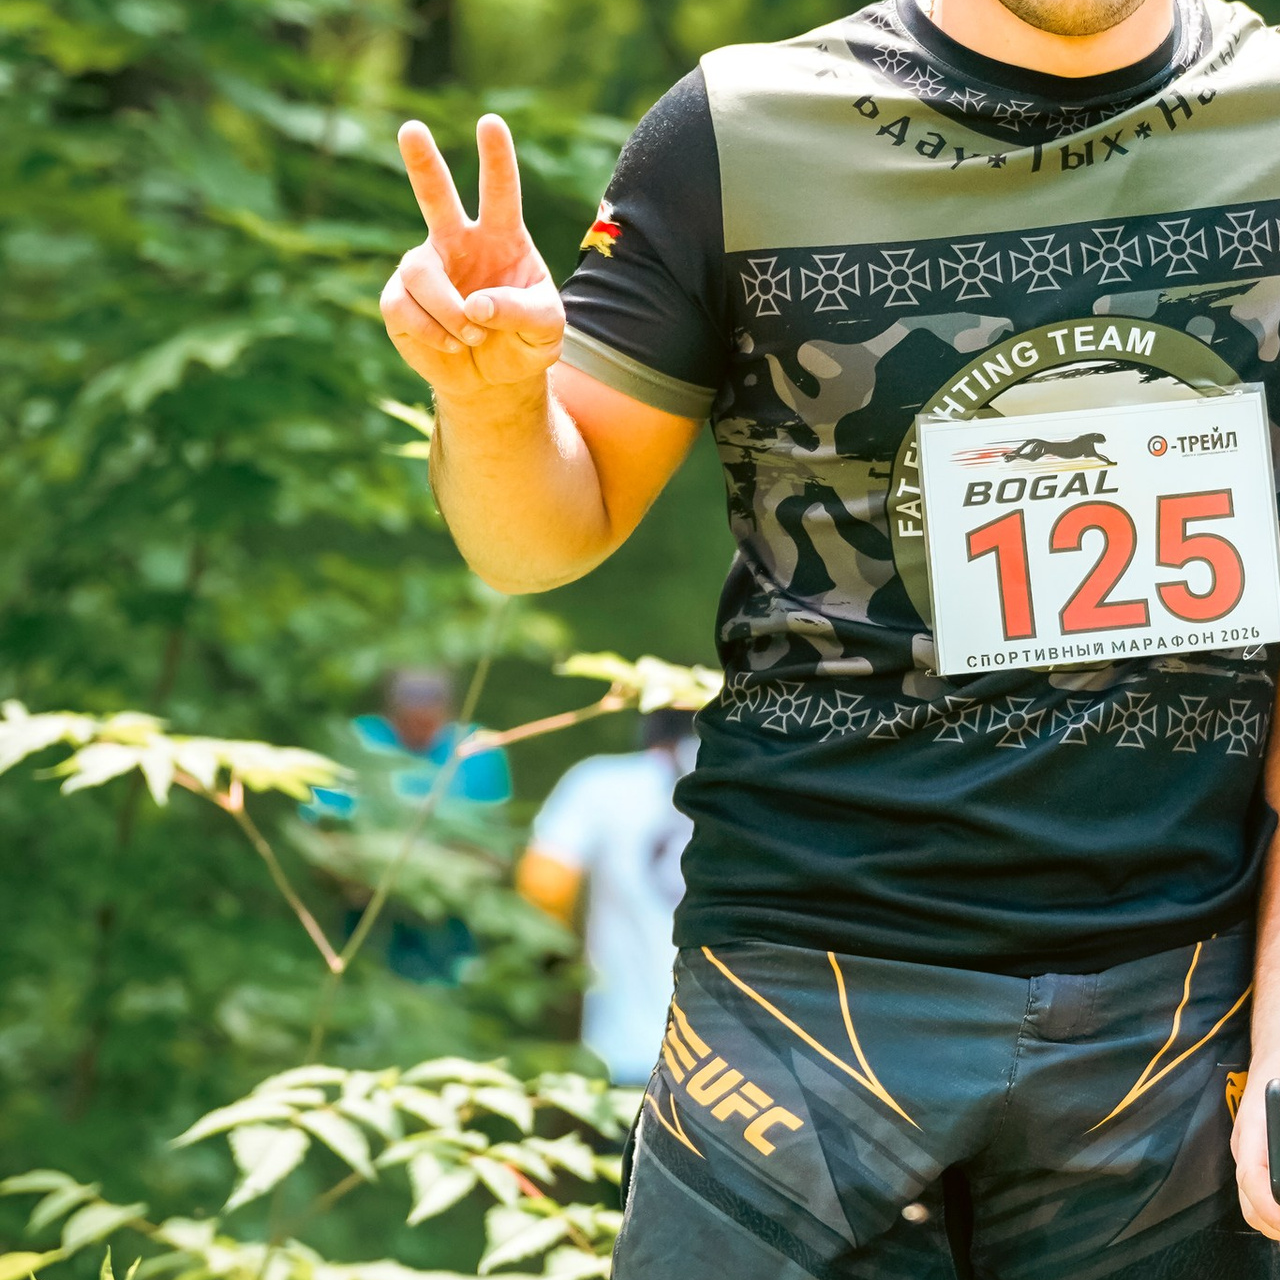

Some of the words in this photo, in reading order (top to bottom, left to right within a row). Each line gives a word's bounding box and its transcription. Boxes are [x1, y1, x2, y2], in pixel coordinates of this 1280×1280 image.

[896, 478, 923, 538] FAT
[1047, 325, 1156, 357] TEAM
[963, 469, 1119, 507] BOGAL
[966, 488, 1246, 641] 125
[966, 641, 1105, 668] СПОРТИВНЫЙ
[1111, 632, 1215, 656] МАРАФОН
[1221, 625, 1260, 643] 2026
[685, 1056, 804, 1157] UFC
